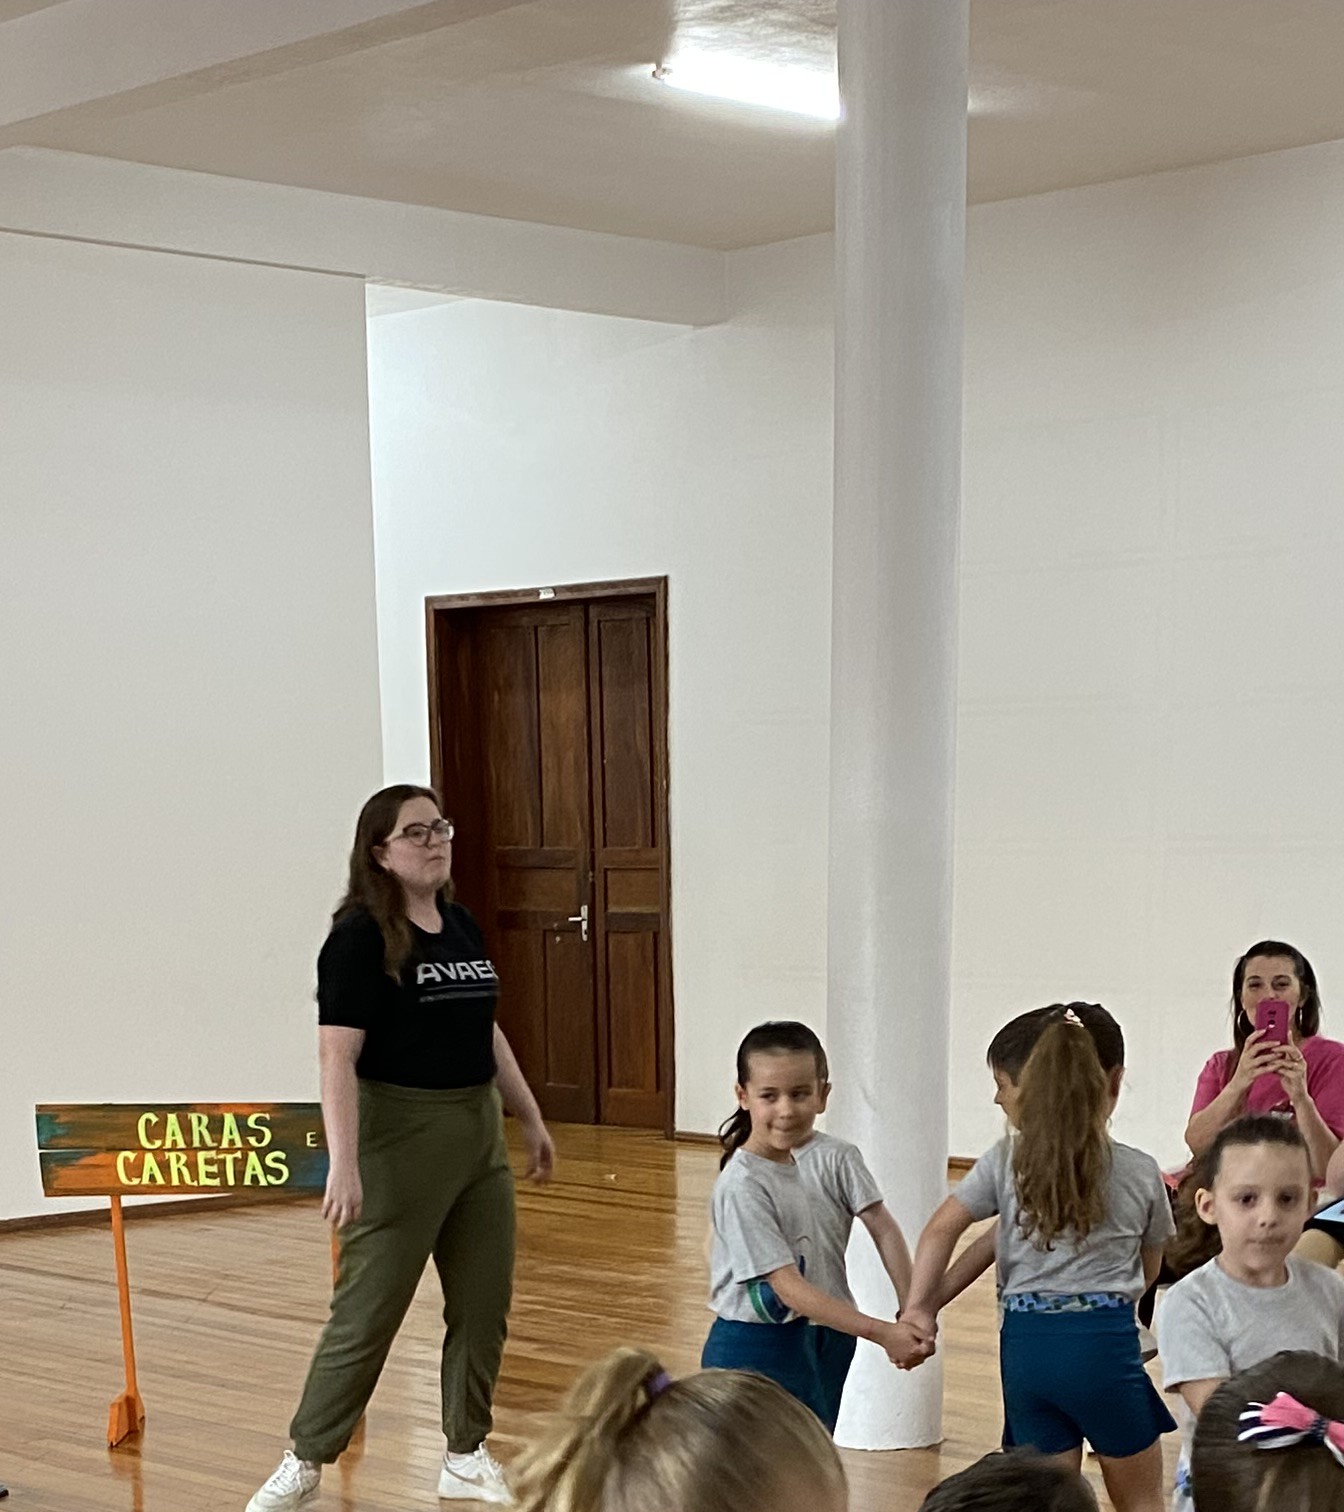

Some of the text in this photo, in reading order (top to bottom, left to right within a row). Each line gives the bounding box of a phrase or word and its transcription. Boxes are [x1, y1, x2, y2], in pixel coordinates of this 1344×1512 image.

[137, 1112, 318, 1149] CARAS E
[116, 1151, 290, 1186] CARETAS
